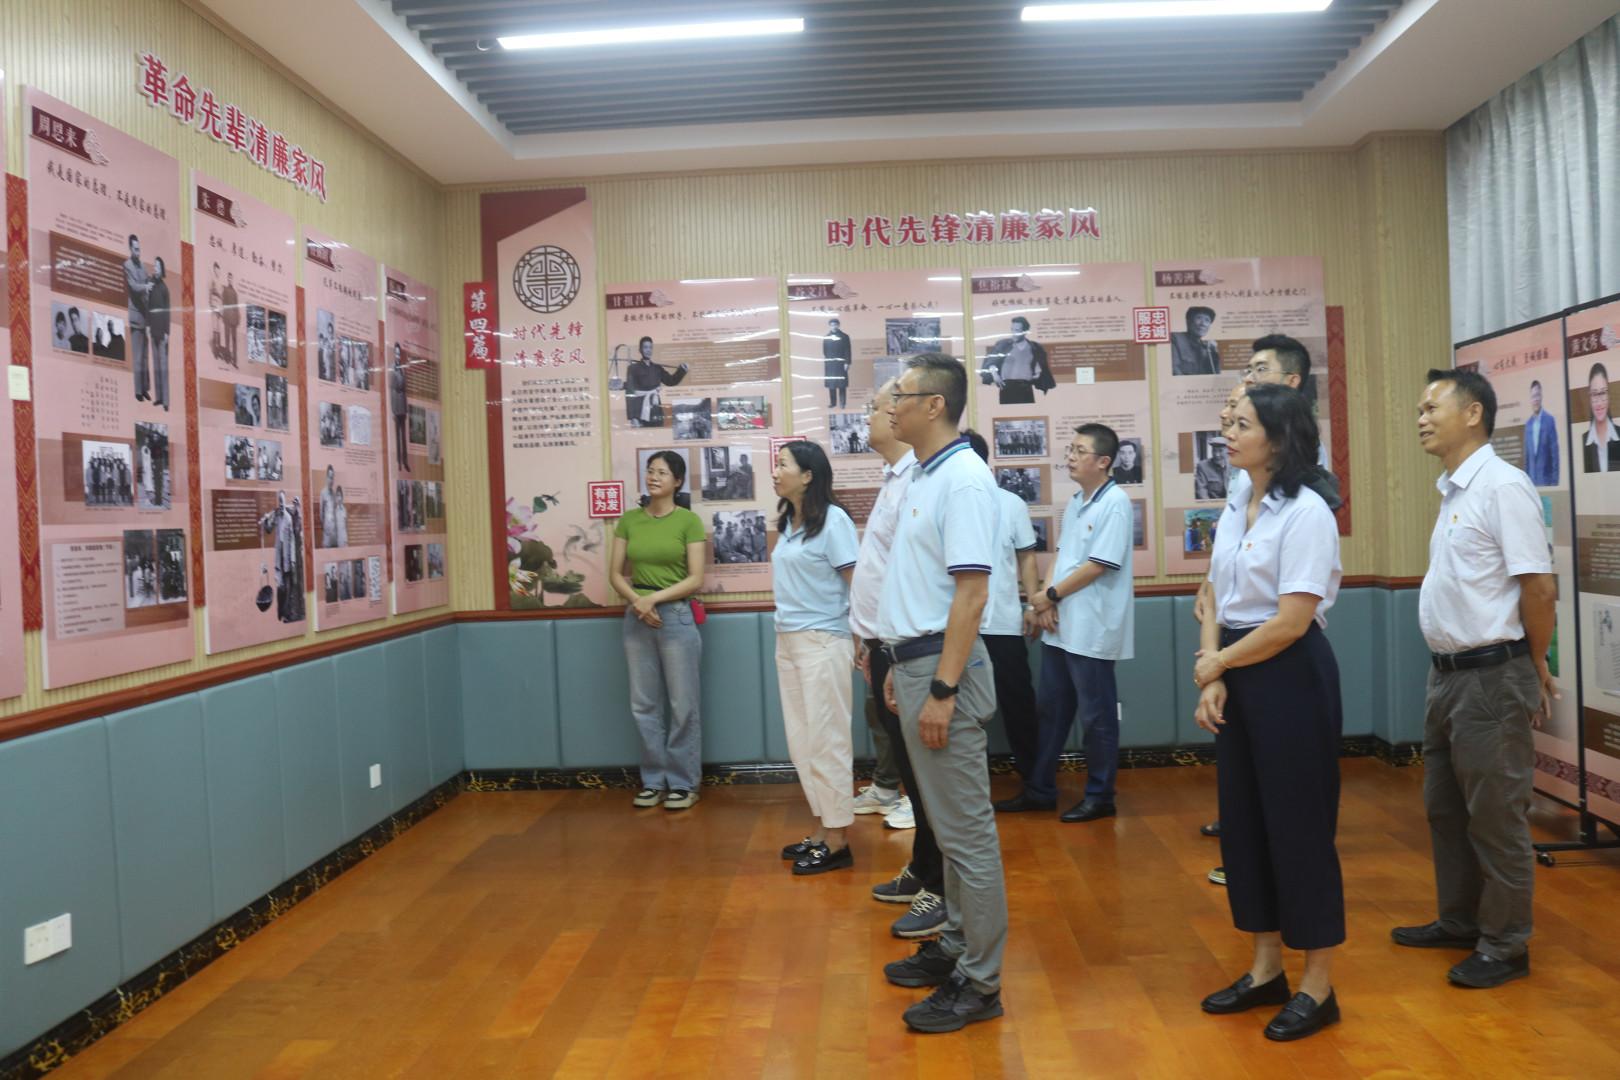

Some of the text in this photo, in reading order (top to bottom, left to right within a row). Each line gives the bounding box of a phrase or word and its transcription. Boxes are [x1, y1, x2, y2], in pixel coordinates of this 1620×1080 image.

[37, 113, 78, 148] 周恩来
[140, 51, 326, 202] 革命先辈清廉家风
[827, 207, 1100, 247] 时代先锋清廉家风
[469, 288, 489, 360] 第四篇
[512, 321, 584, 342] 时代先锋
[512, 347, 586, 369] 清廉家风
[1571, 333, 1599, 355] 黄文秀
